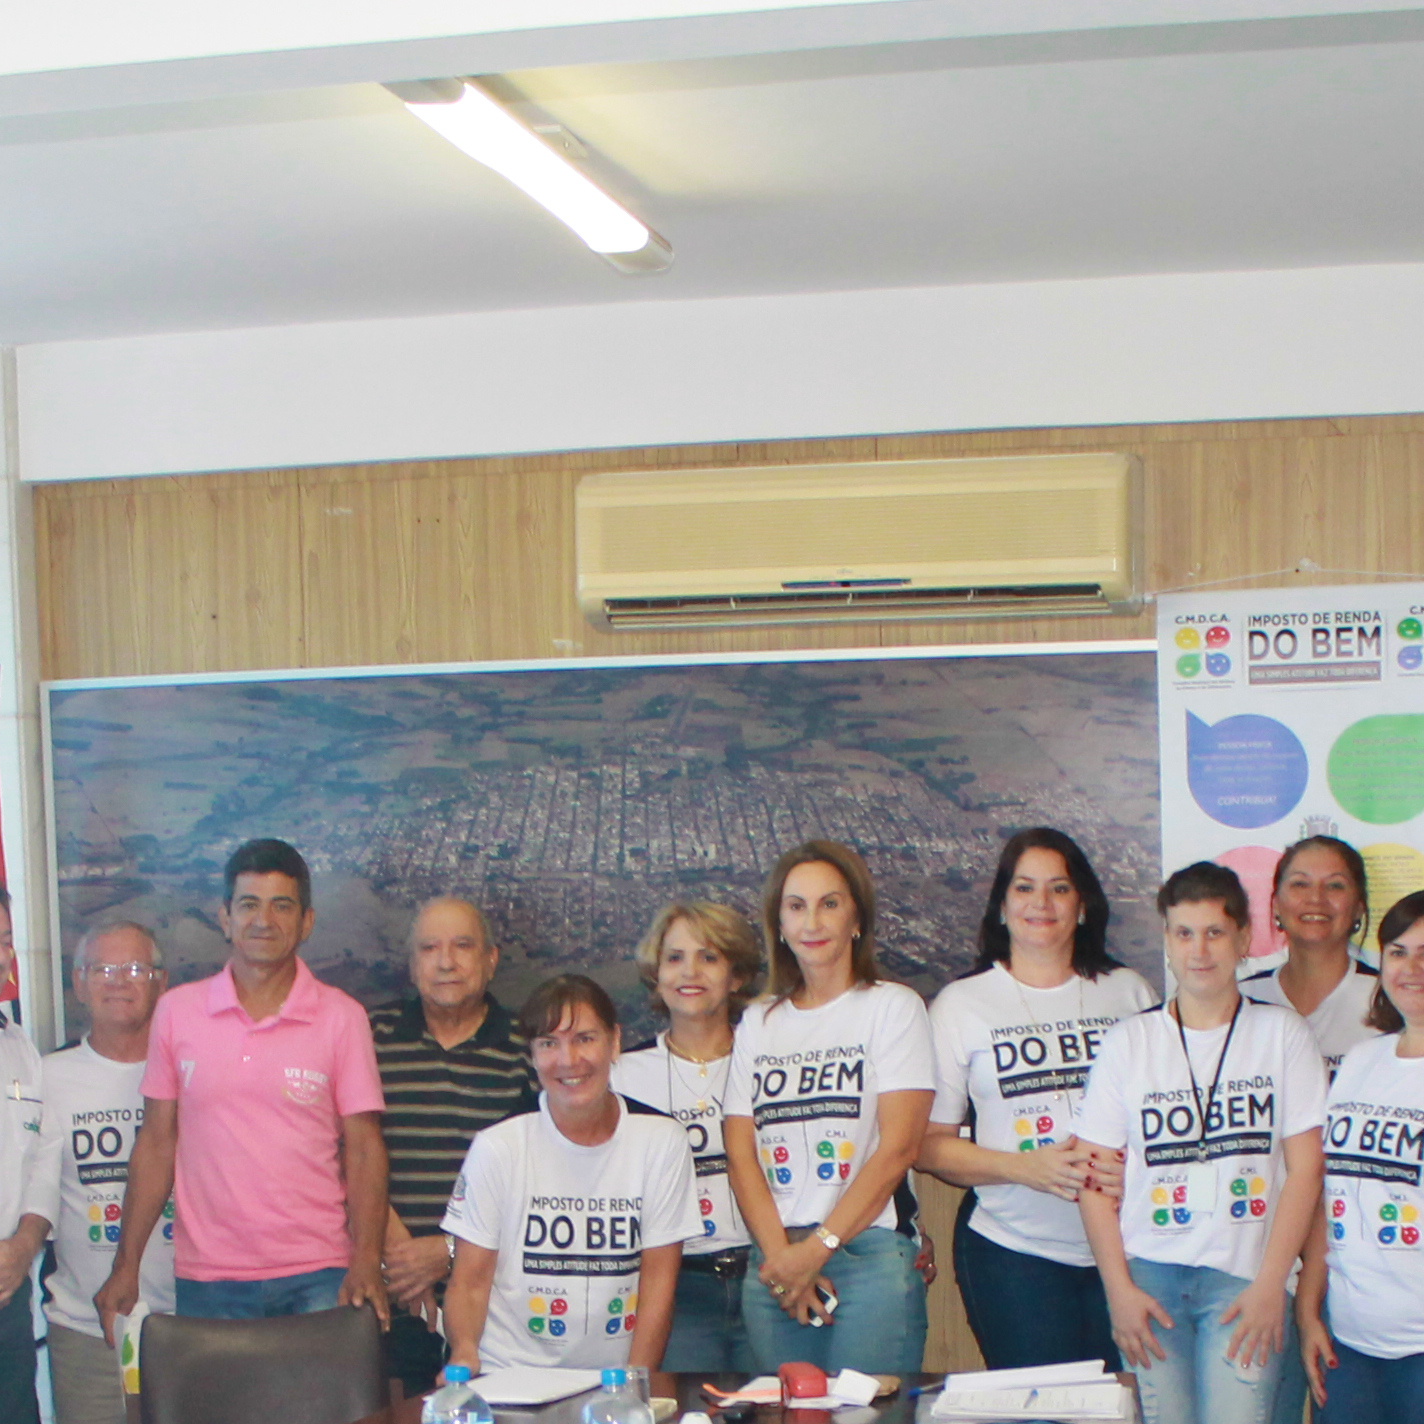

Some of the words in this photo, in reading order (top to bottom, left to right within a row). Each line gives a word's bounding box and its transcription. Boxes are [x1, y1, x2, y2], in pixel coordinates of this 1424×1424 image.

[1175, 613, 1231, 625] C.M.D.C.A.
[1247, 613, 1309, 627] IMPOSTO
[1312, 611, 1332, 625] DE
[1334, 611, 1382, 624] RENDA
[1248, 628, 1298, 661] DO
[1311, 625, 1382, 660] BEM
[990, 1023, 1052, 1041] IMPOSTO
[1056, 1020, 1075, 1032] DE
[804, 1051, 824, 1063] DE
[825, 1044, 866, 1060] RENDA
[993, 1036, 1047, 1073] DO
[1058, 1029, 1107, 1063] BE
[180, 1060, 196, 1088] 7
[798, 1059, 864, 1095] BEM
[1228, 1075, 1274, 1092] RENDA
[72, 1109, 132, 1126] IMPOSTO
[136, 1109, 145, 1120] D
[1141, 1105, 1194, 1142] DO
[1205, 1093, 1275, 1133] BEM
[72, 1126, 123, 1161] DO
[531, 1196, 584, 1212] MPOSTO
[588, 1198, 606, 1212] DE
[610, 1197, 642, 1212] REND
[524, 1214, 575, 1249] DO
